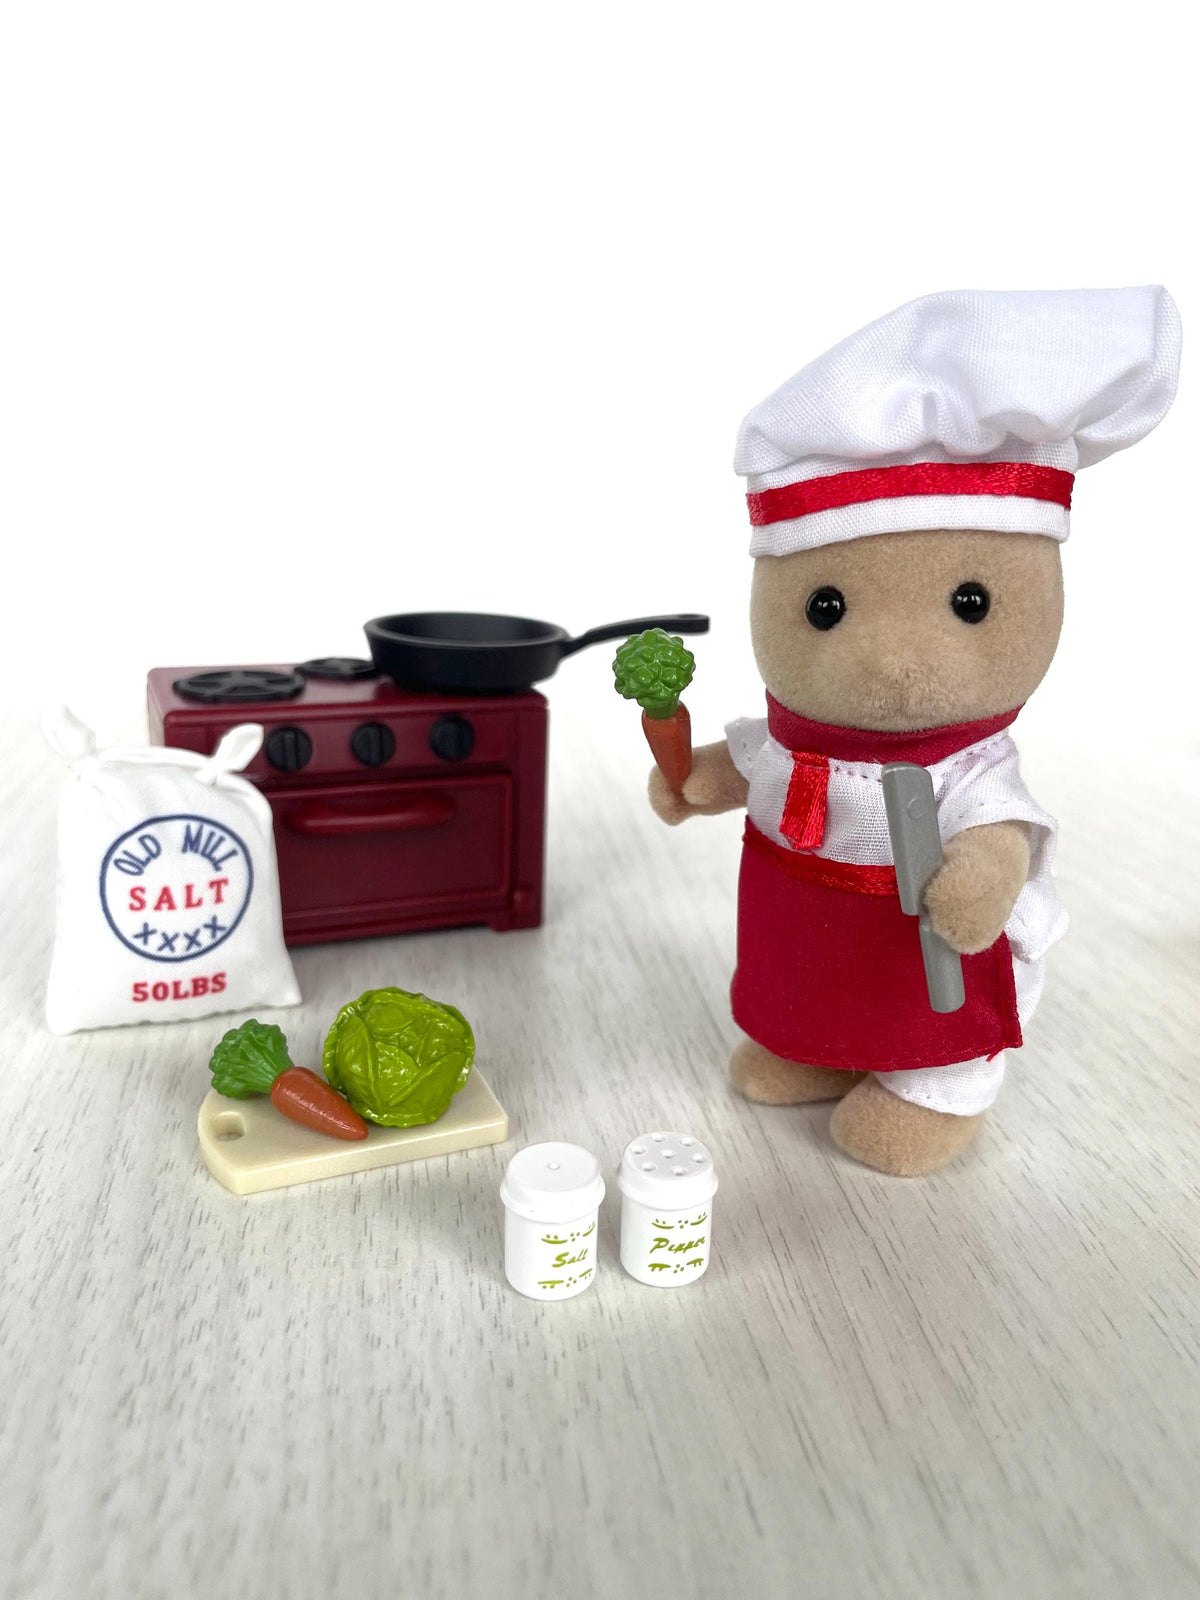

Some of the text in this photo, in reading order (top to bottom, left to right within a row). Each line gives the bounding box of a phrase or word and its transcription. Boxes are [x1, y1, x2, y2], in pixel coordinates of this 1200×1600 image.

[114, 824, 238, 875] OLD MILL
[129, 878, 228, 911] SALT
[552, 1249, 588, 1268] Salt
[650, 1237, 705, 1254] Pepper
